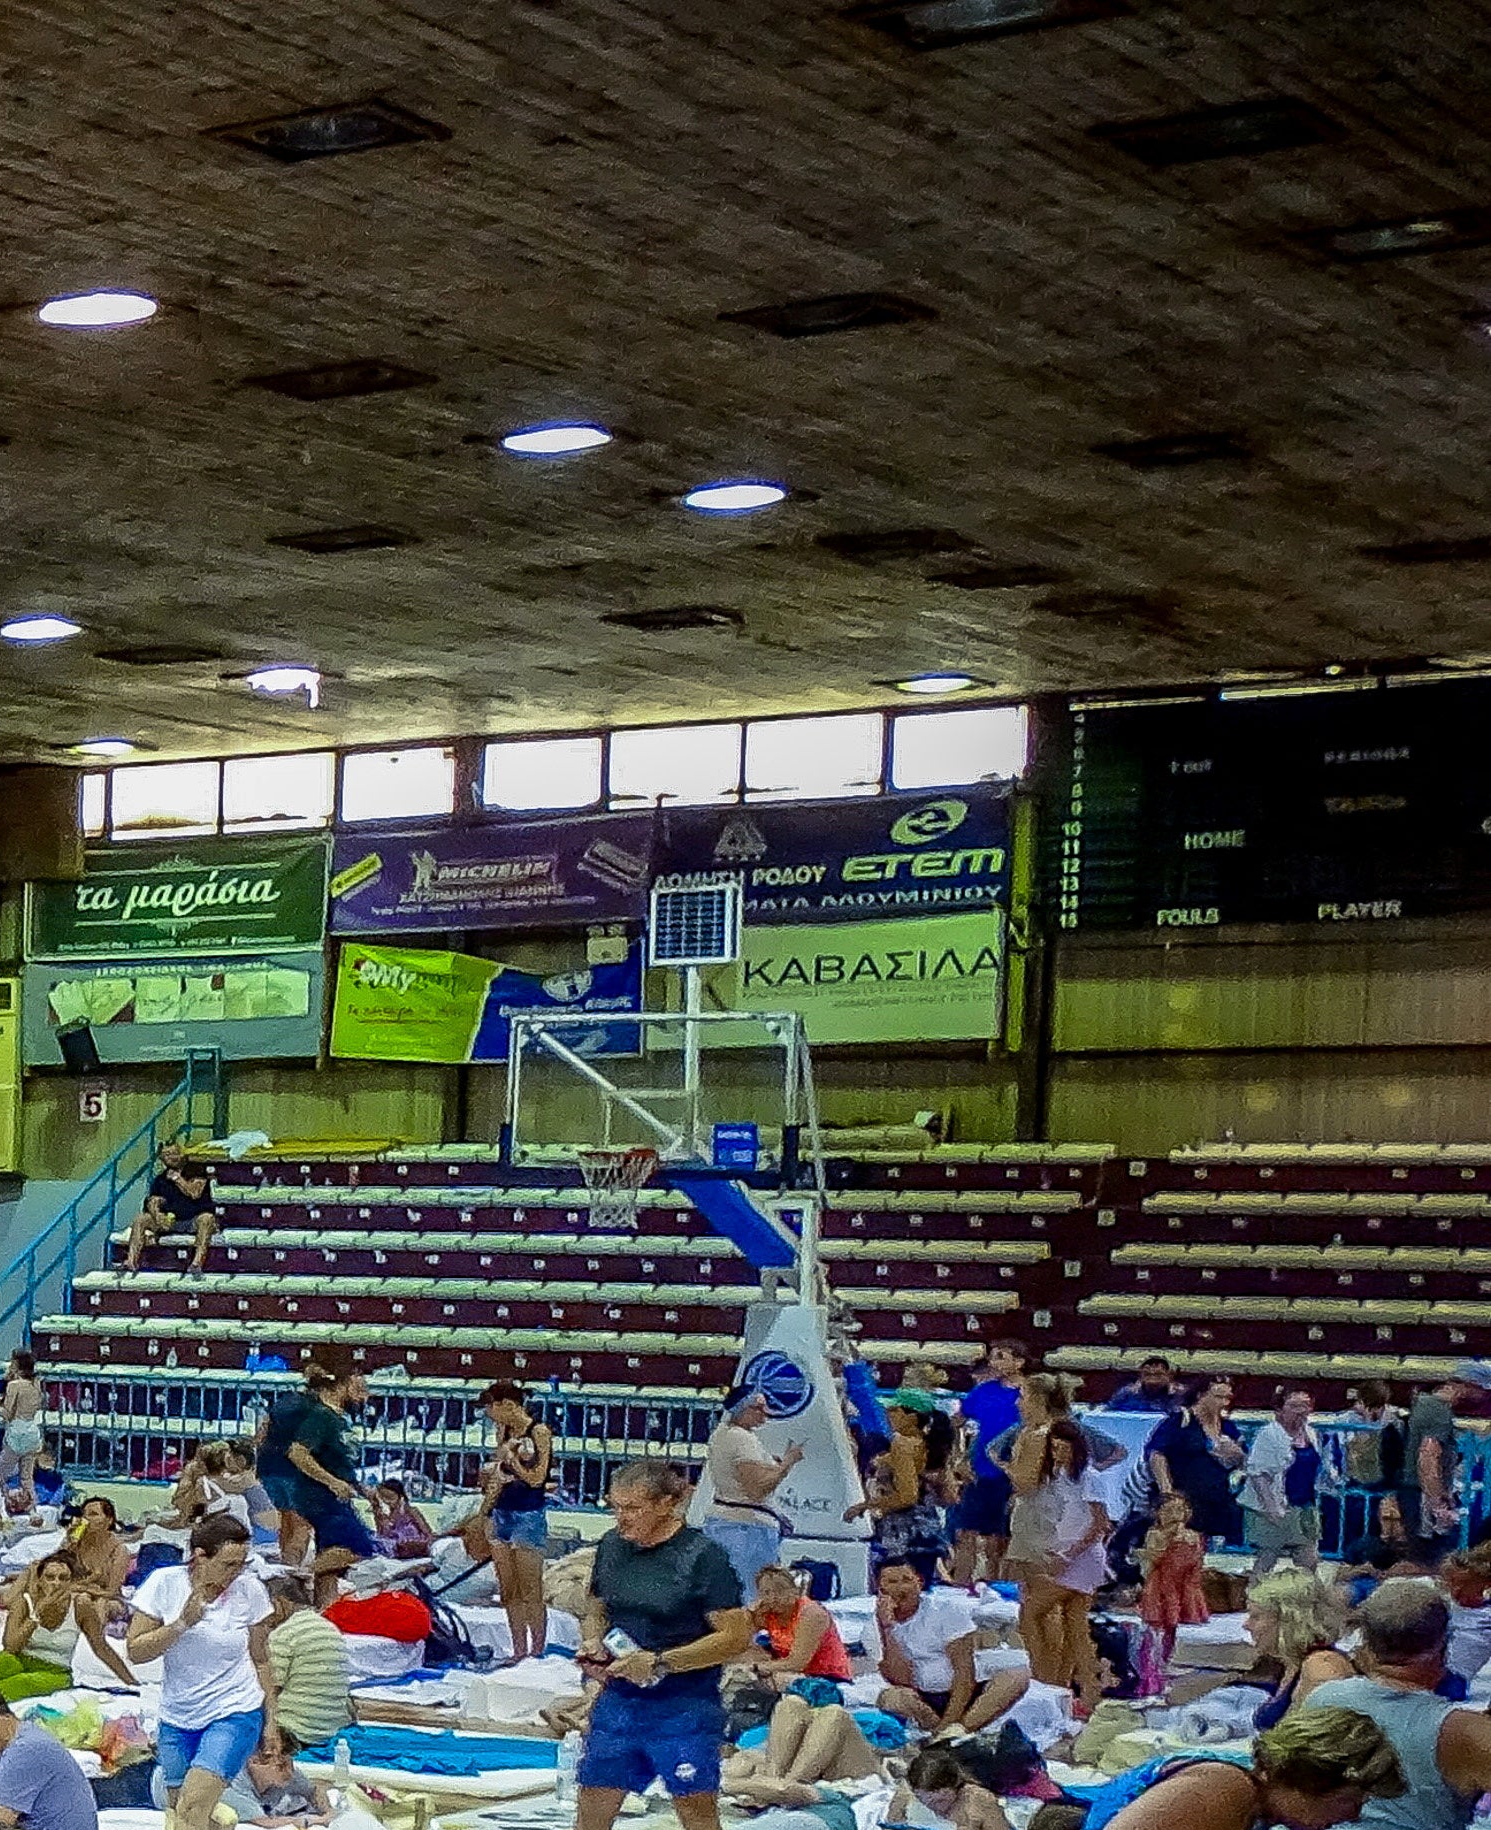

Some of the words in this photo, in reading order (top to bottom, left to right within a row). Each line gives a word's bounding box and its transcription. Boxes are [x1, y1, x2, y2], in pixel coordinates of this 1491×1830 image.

[1062, 821, 1083, 837] 10
[1184, 829, 1246, 850] HOME
[1062, 840, 1082, 855] 11
[752, 864, 826, 886] ΡΟΔΟΥ
[1061, 858, 1081, 873] 12
[1060, 876, 1080, 891] 13
[76, 884, 120, 912] τα
[122, 870, 282, 920] μαράσια
[1318, 900, 1403, 921] PLAYER
[82, 1093, 103, 1118] 5
